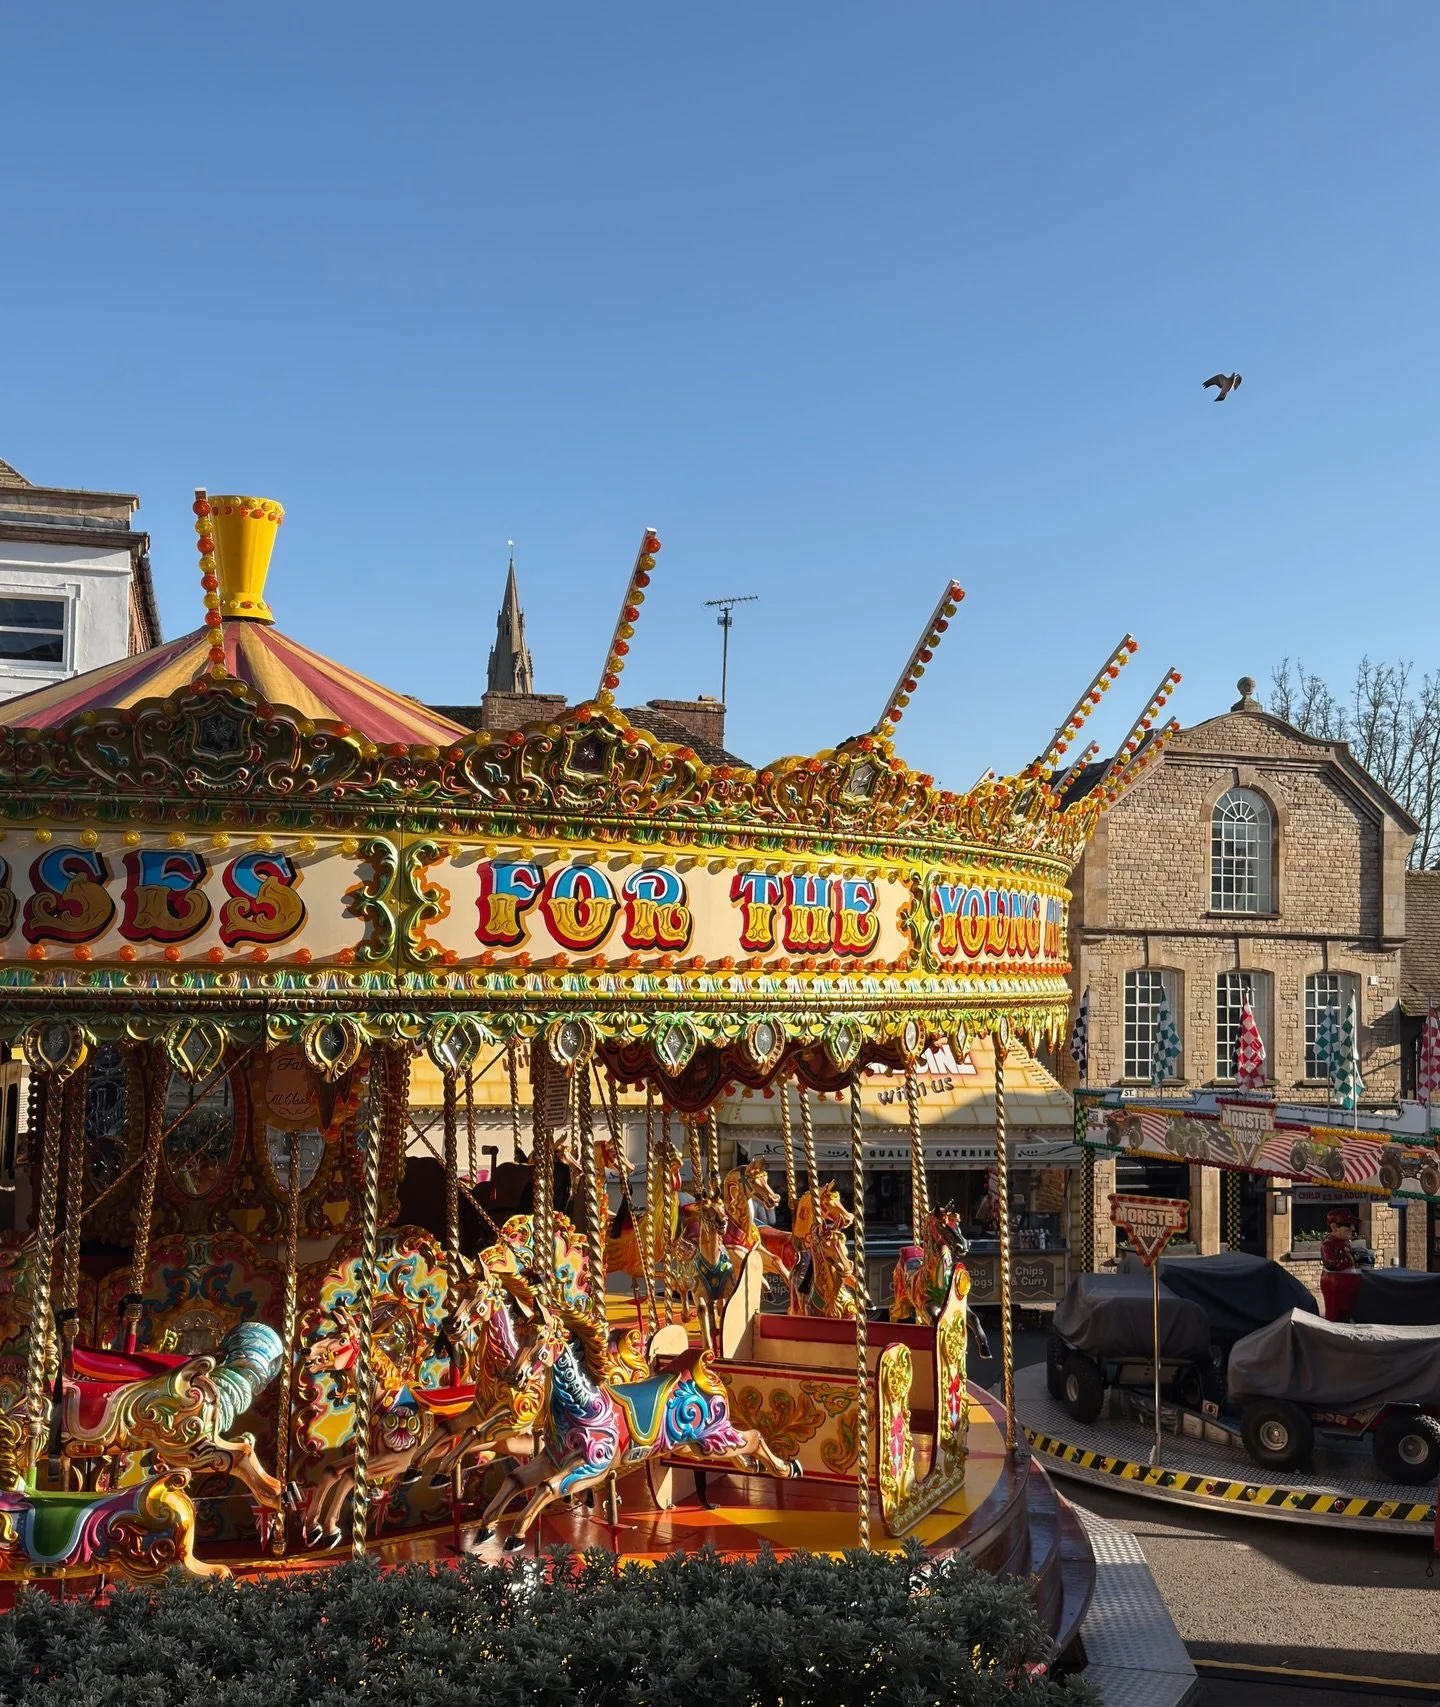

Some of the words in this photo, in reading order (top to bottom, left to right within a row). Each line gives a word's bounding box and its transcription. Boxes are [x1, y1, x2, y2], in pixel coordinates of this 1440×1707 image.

[0, 844, 305, 948] SES
[475, 860, 692, 952] FOR
[730, 872, 880, 957] THE
[932, 886, 1040, 958] YOUNG
[930, 1076, 955, 1094] us
[1222, 1109, 1274, 1132] MONSTER
[1233, 1129, 1262, 1145] TRUCKS
[869, 1149, 927, 1158] QUALIY
[1344, 1191, 1367, 1199] ADULT
[1116, 1206, 1183, 1227] MONSTER
[1132, 1224, 1167, 1239] TRUCK
[1015, 1266, 1044, 1277] Chips
[1021, 1276, 1048, 1288] Curry
[558, 1352, 591, 1407] JOHN
